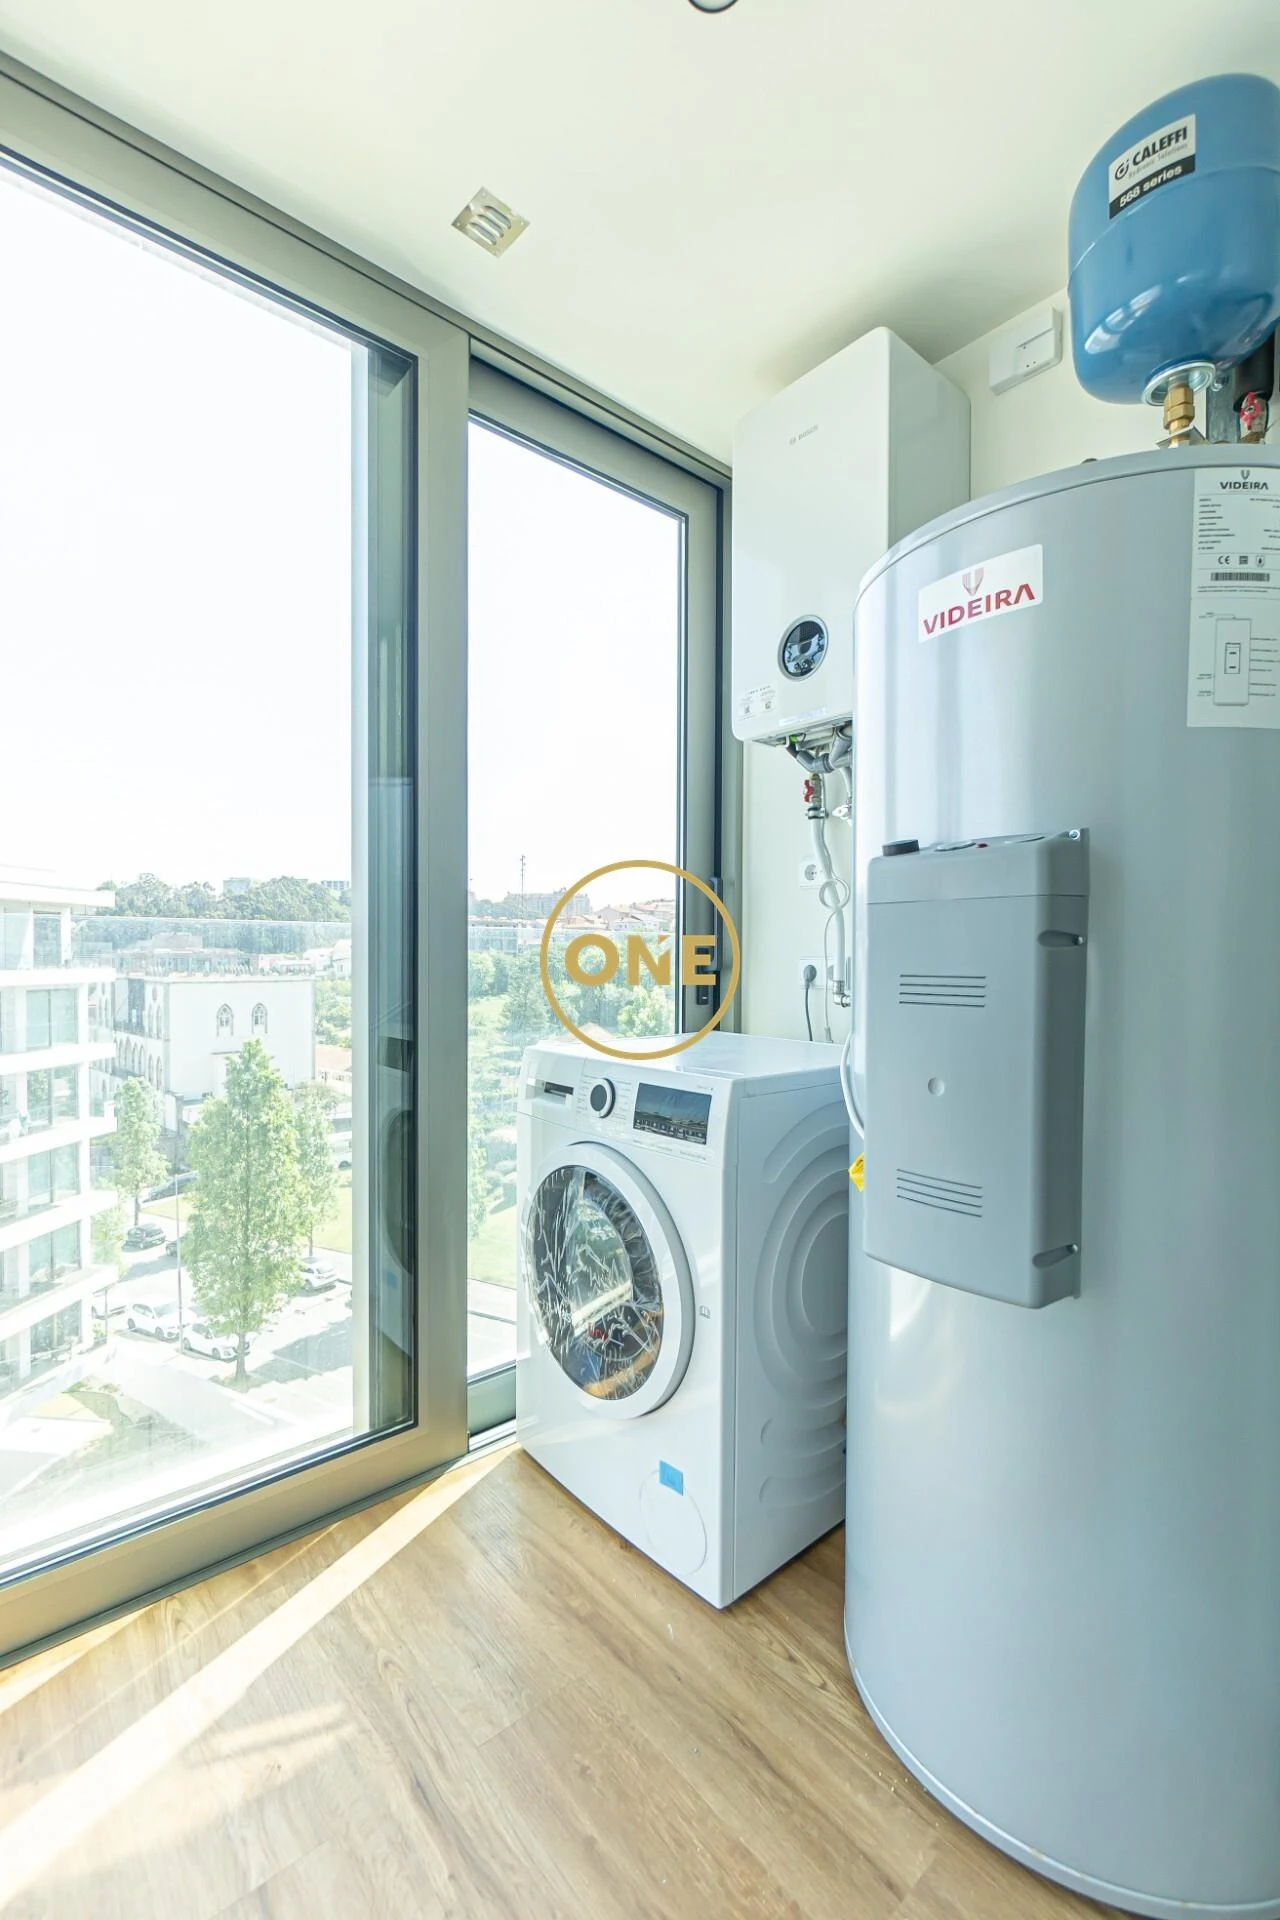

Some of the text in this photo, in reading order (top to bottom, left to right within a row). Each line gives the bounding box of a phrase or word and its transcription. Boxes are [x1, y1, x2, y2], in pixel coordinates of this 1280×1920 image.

[1132, 126, 1187, 166] CALEFFI
[1119, 165, 1183, 208] 568 series
[1219, 481, 1269, 490] VIDEIRA
[923, 583, 1035, 635] VIDEIRA
